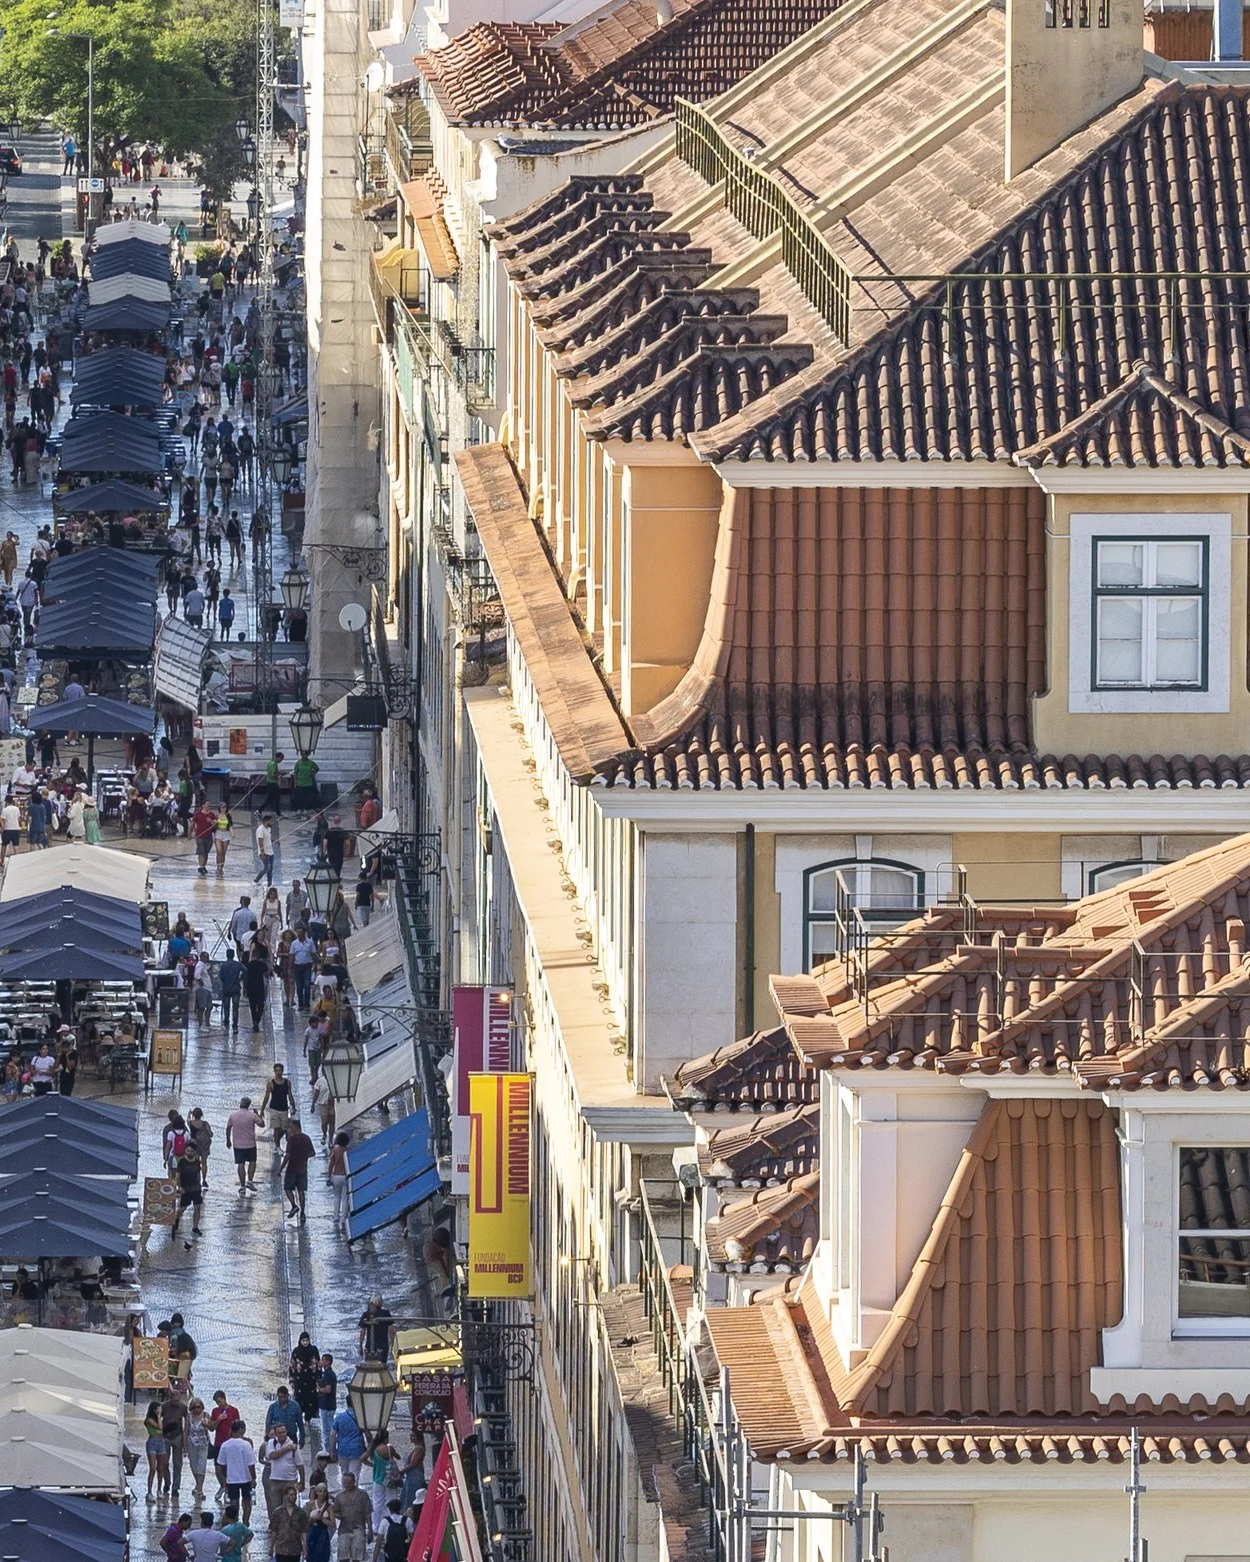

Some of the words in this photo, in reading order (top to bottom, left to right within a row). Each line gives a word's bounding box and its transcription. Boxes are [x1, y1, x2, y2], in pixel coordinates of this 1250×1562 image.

[508, 1082, 530, 1194] MILLENNIUM
[474, 1252, 506, 1263] FUNDAÇÃO
[474, 1264, 524, 1273] MILLENNIUM
[508, 1274, 524, 1284] BCP
[414, 1375, 451, 1383] CASA
